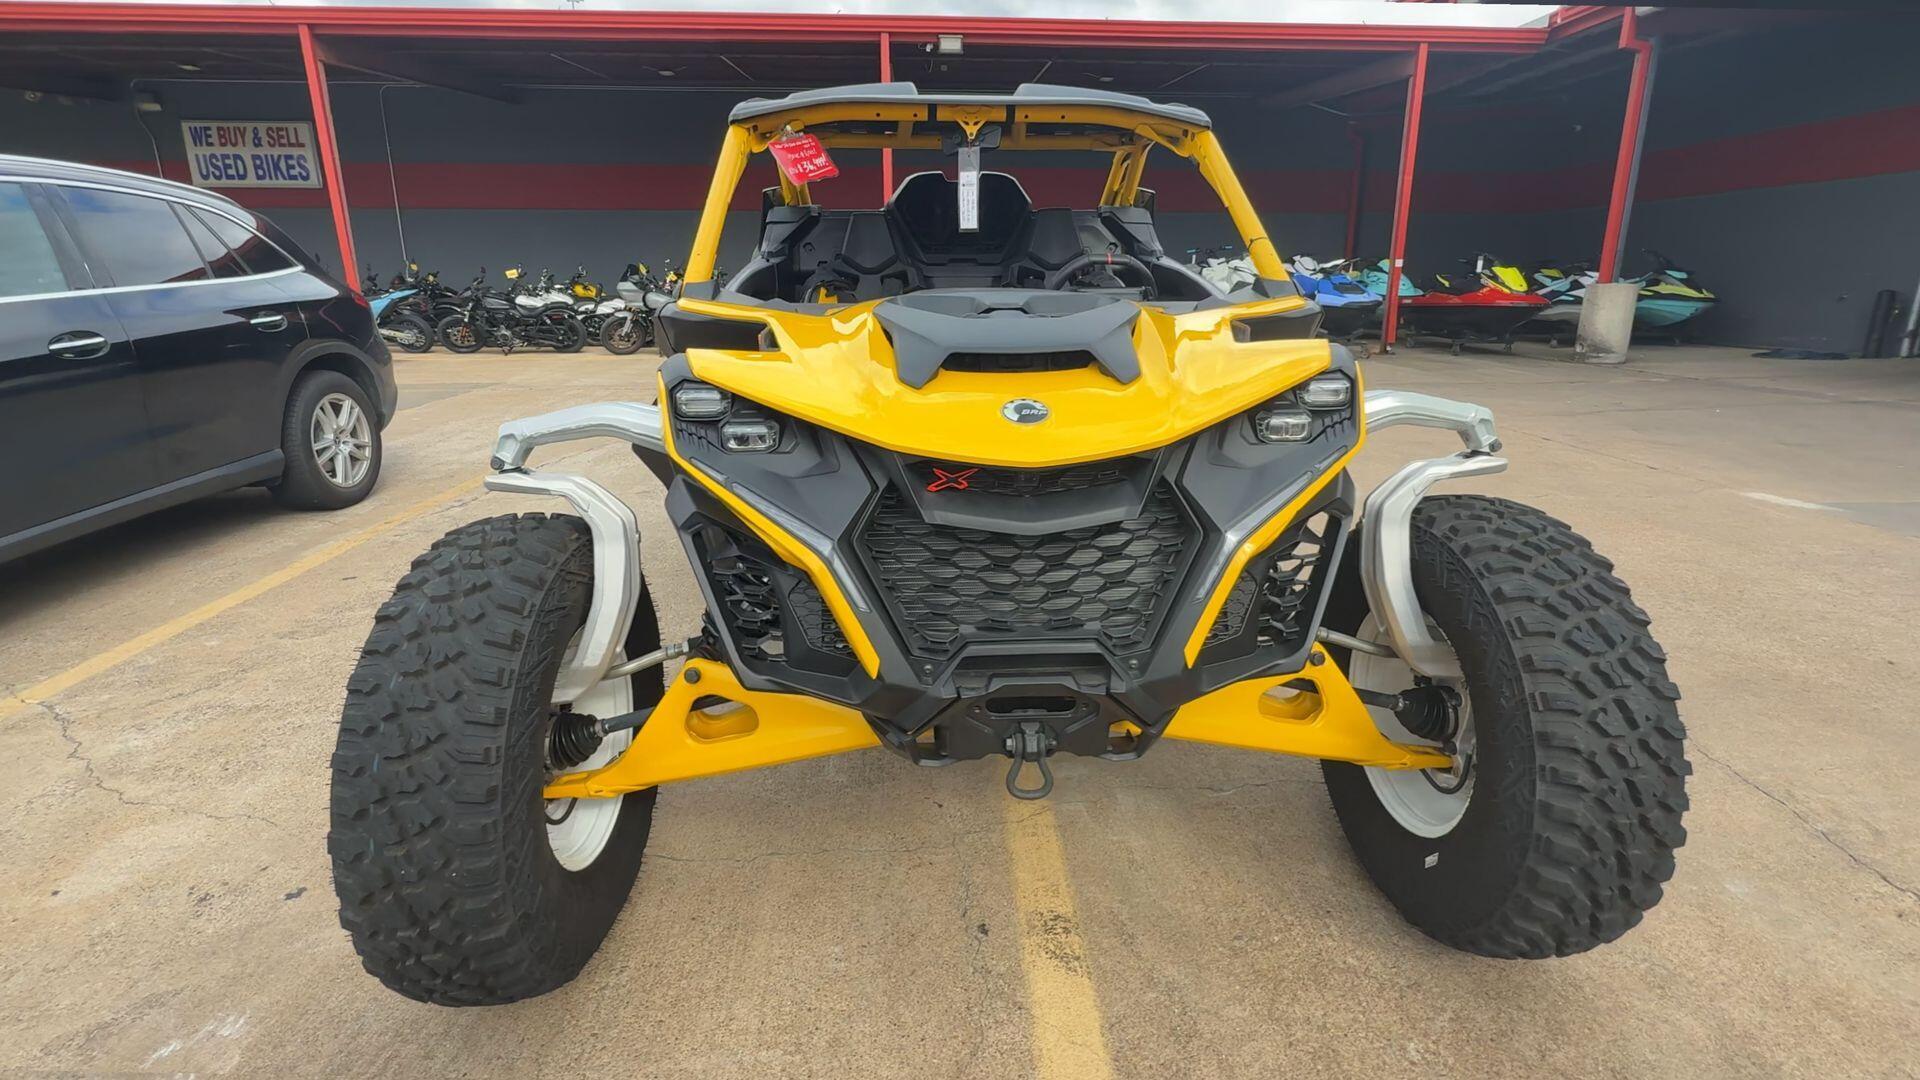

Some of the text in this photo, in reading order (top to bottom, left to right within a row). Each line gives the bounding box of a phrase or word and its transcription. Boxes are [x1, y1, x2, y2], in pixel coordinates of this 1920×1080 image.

[189, 126, 305, 148] WE BUY & SELL
[195, 153, 310, 182] USED BIKES
